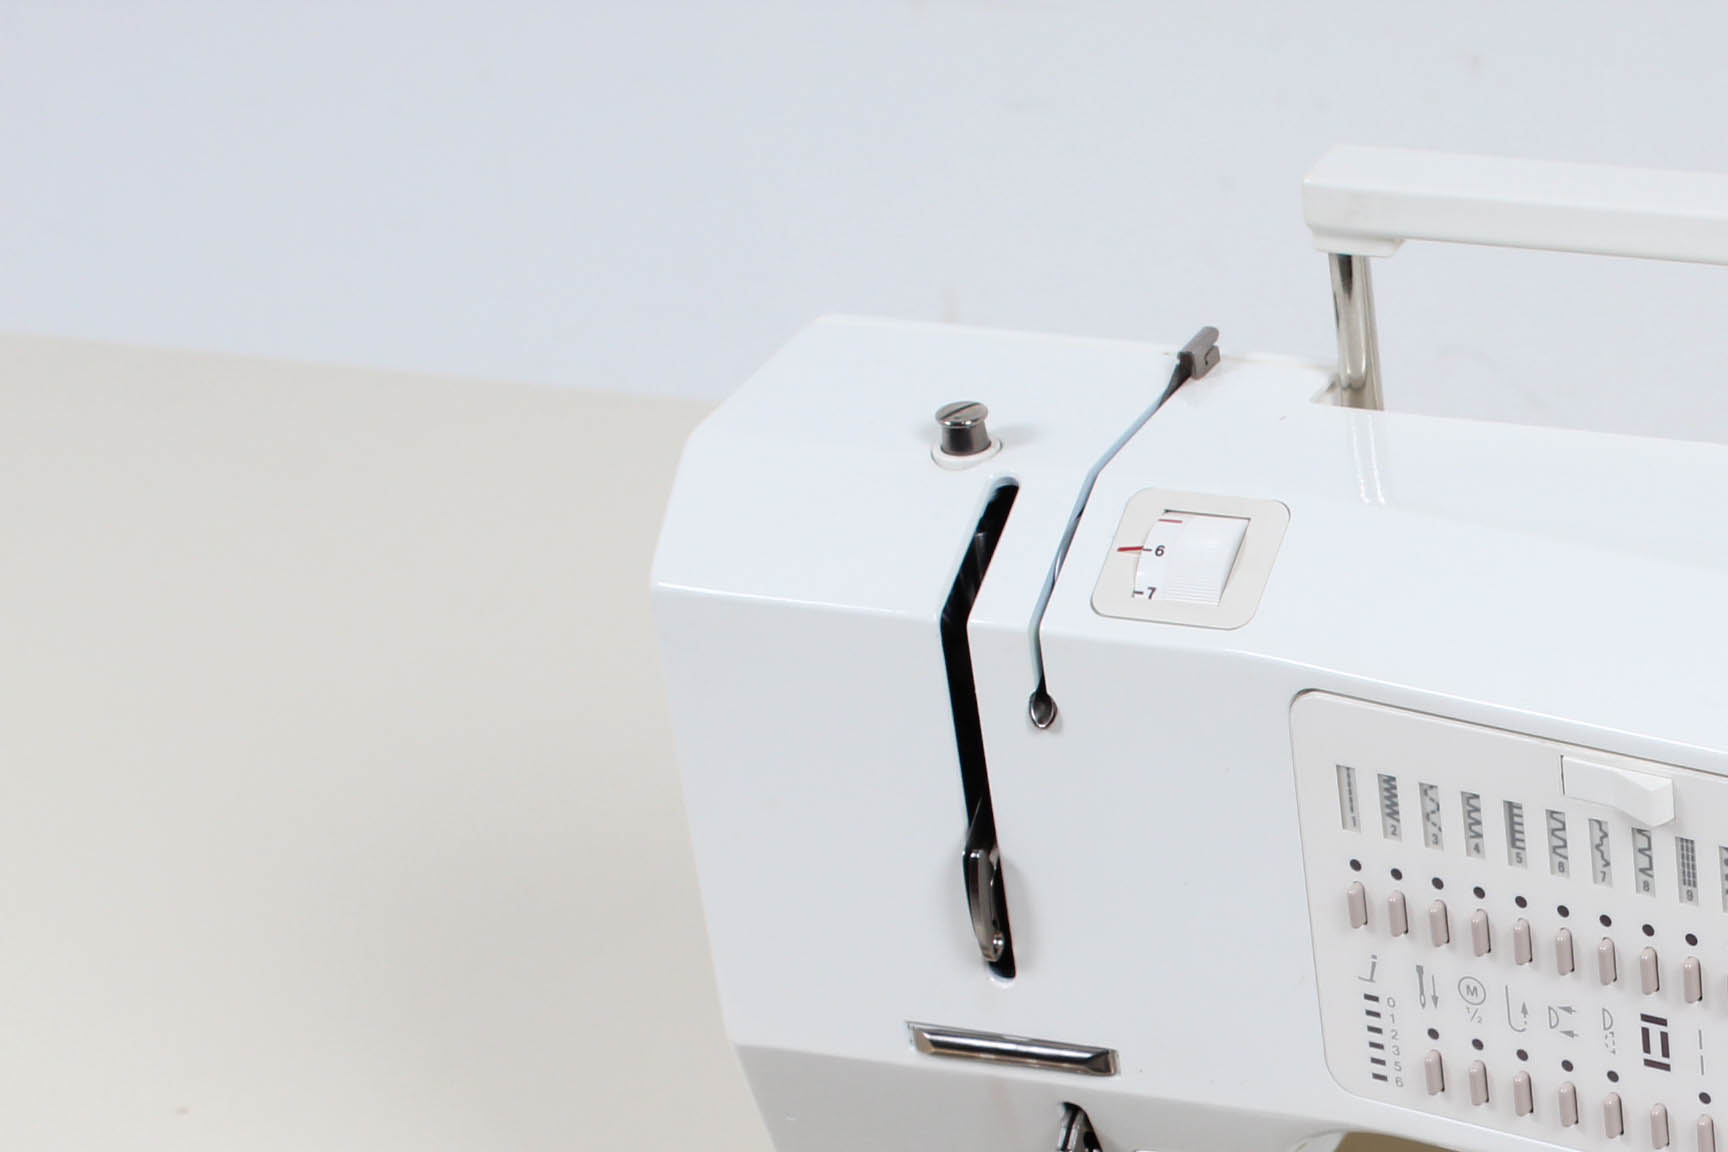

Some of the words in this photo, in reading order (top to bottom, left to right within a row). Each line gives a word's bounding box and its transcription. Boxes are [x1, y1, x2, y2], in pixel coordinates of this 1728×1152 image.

[1154, 545, 1165, 557] 6
[1146, 587, 1157, 600] 7
[1389, 824, 1398, 836] 2
[1473, 843, 1481, 855] 4
[1515, 852, 1523, 864] 5
[1600, 871, 1607, 883] 7
[1642, 880, 1651, 893] 8
[1686, 890, 1694, 902] 9
[1390, 1029, 1399, 1041] 2
[1392, 1045, 1400, 1056] 3
[1394, 1061, 1402, 1073] 5
